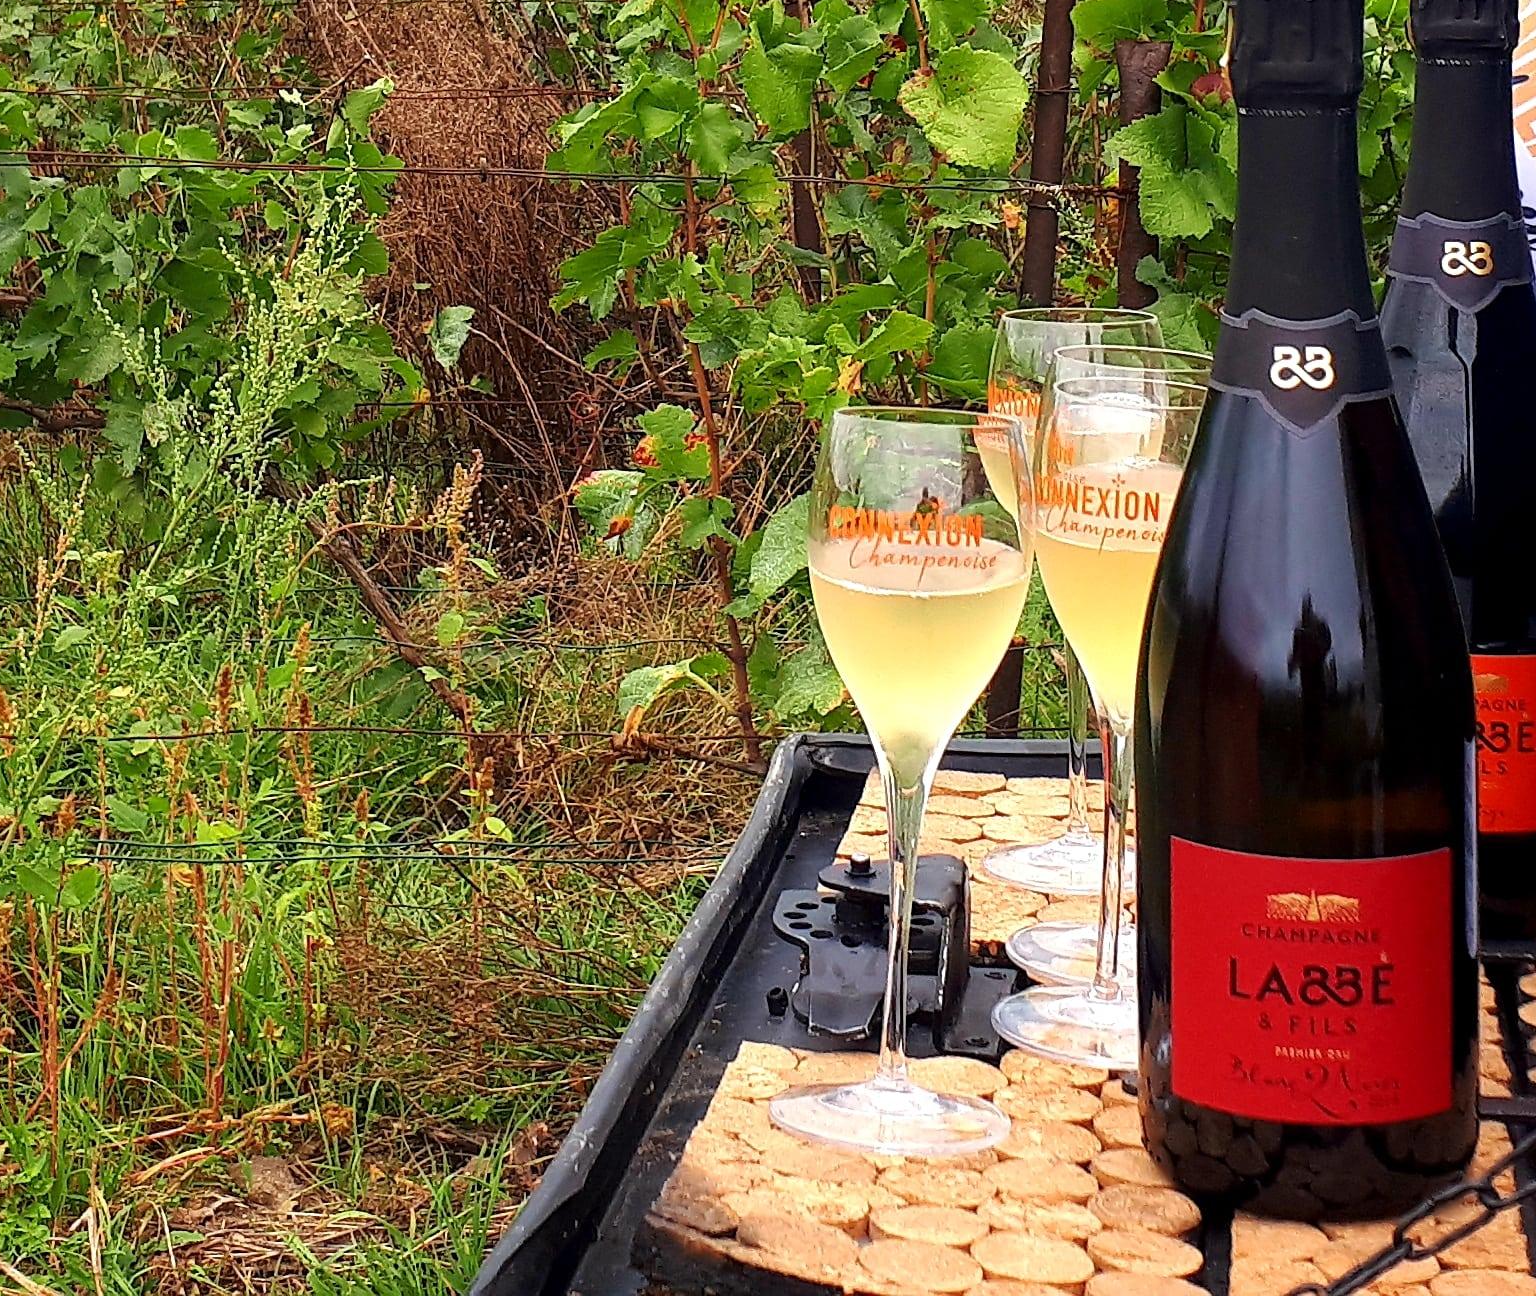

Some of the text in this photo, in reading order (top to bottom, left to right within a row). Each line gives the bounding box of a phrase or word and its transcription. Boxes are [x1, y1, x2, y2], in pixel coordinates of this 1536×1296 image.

[849, 533, 998, 587] Champenoise
[1475, 698, 1527, 712] AGNE
[1241, 922, 1381, 944] CHAMPAGNE
[1258, 1012, 1358, 1035] & FILS
